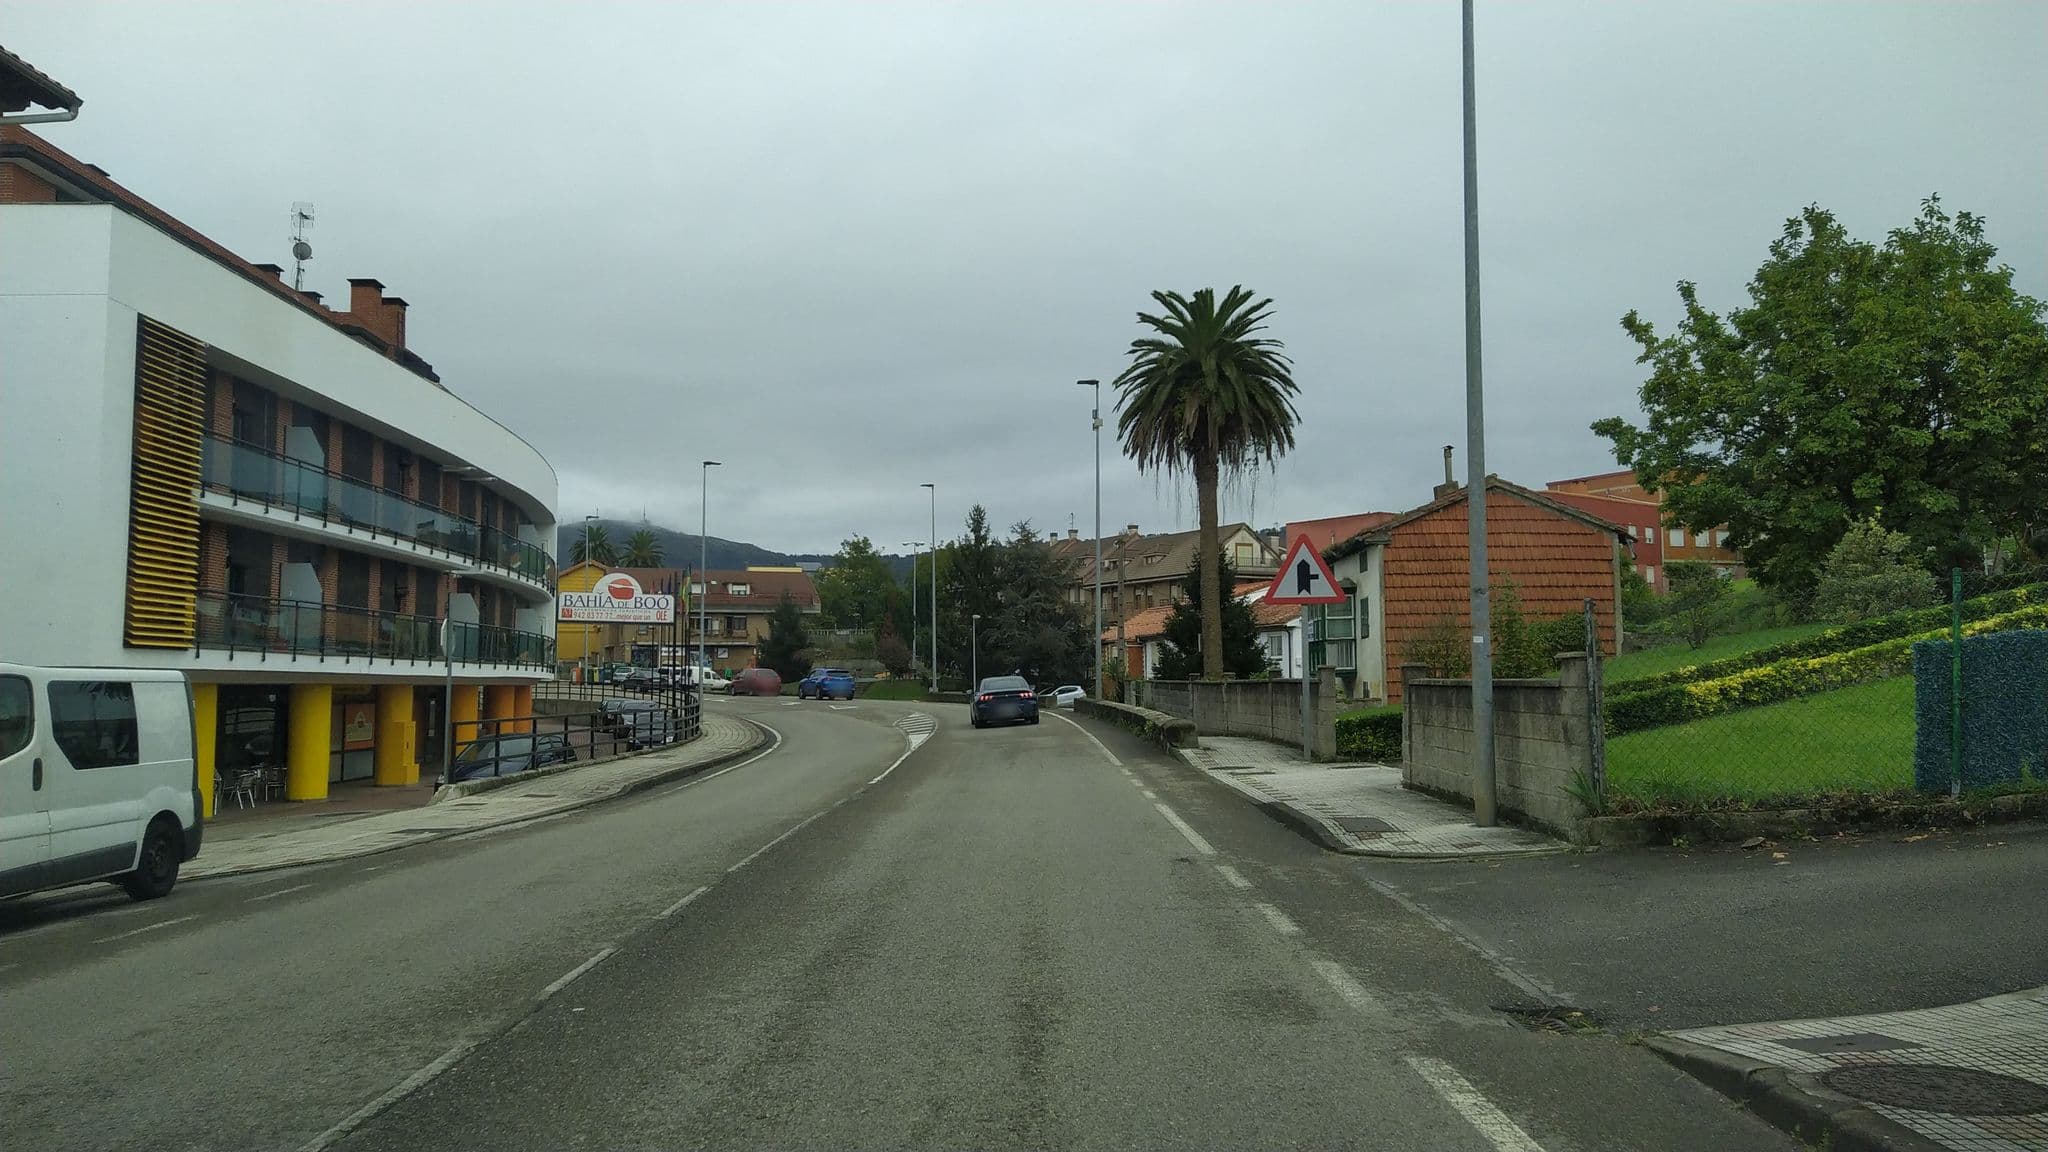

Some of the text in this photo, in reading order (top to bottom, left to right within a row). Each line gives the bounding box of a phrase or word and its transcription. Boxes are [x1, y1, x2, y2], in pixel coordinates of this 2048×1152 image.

[564, 592, 669, 609] BAHÍA DE BOÓ
